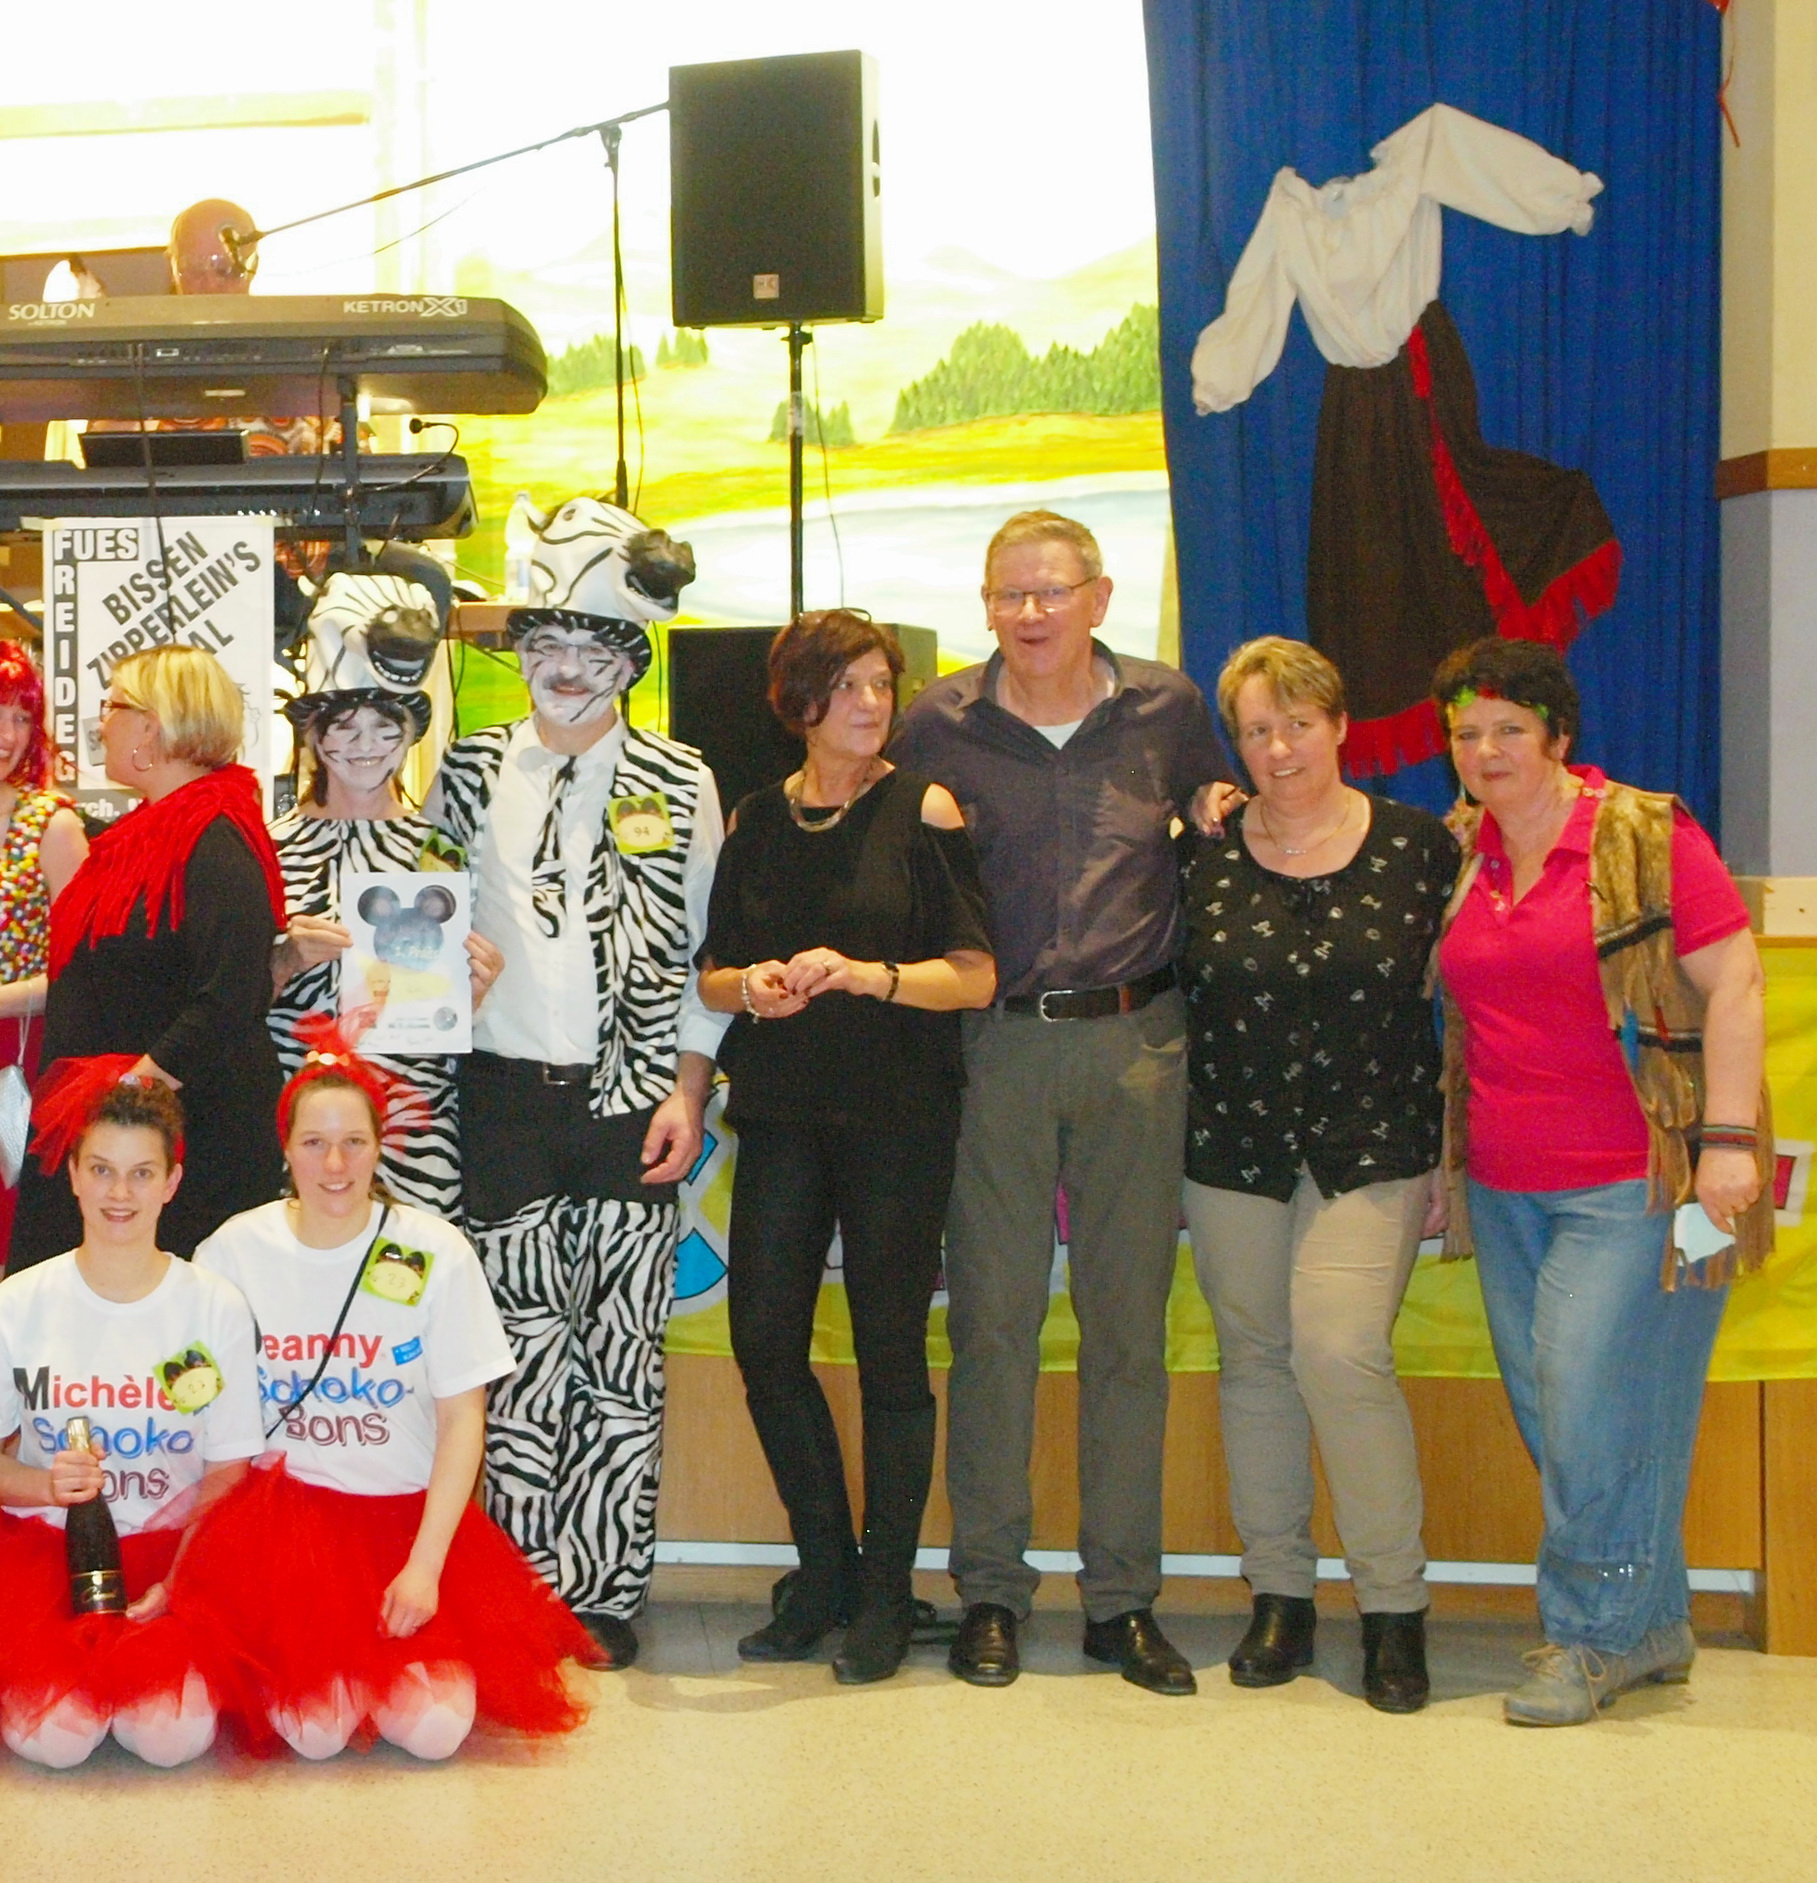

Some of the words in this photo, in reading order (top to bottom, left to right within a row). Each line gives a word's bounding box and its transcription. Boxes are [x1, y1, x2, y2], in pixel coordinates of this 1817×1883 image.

[8, 303, 95, 320] SOLTON
[344, 300, 424, 313] KETRON
[54, 529, 138, 562] FUES
[102, 531, 208, 626] BISSEN
[187, 619, 235, 655] AL
[255, 1318, 382, 1369] eanny
[279, 1404, 390, 1446] Bons
[102, 1467, 170, 1503] ons
